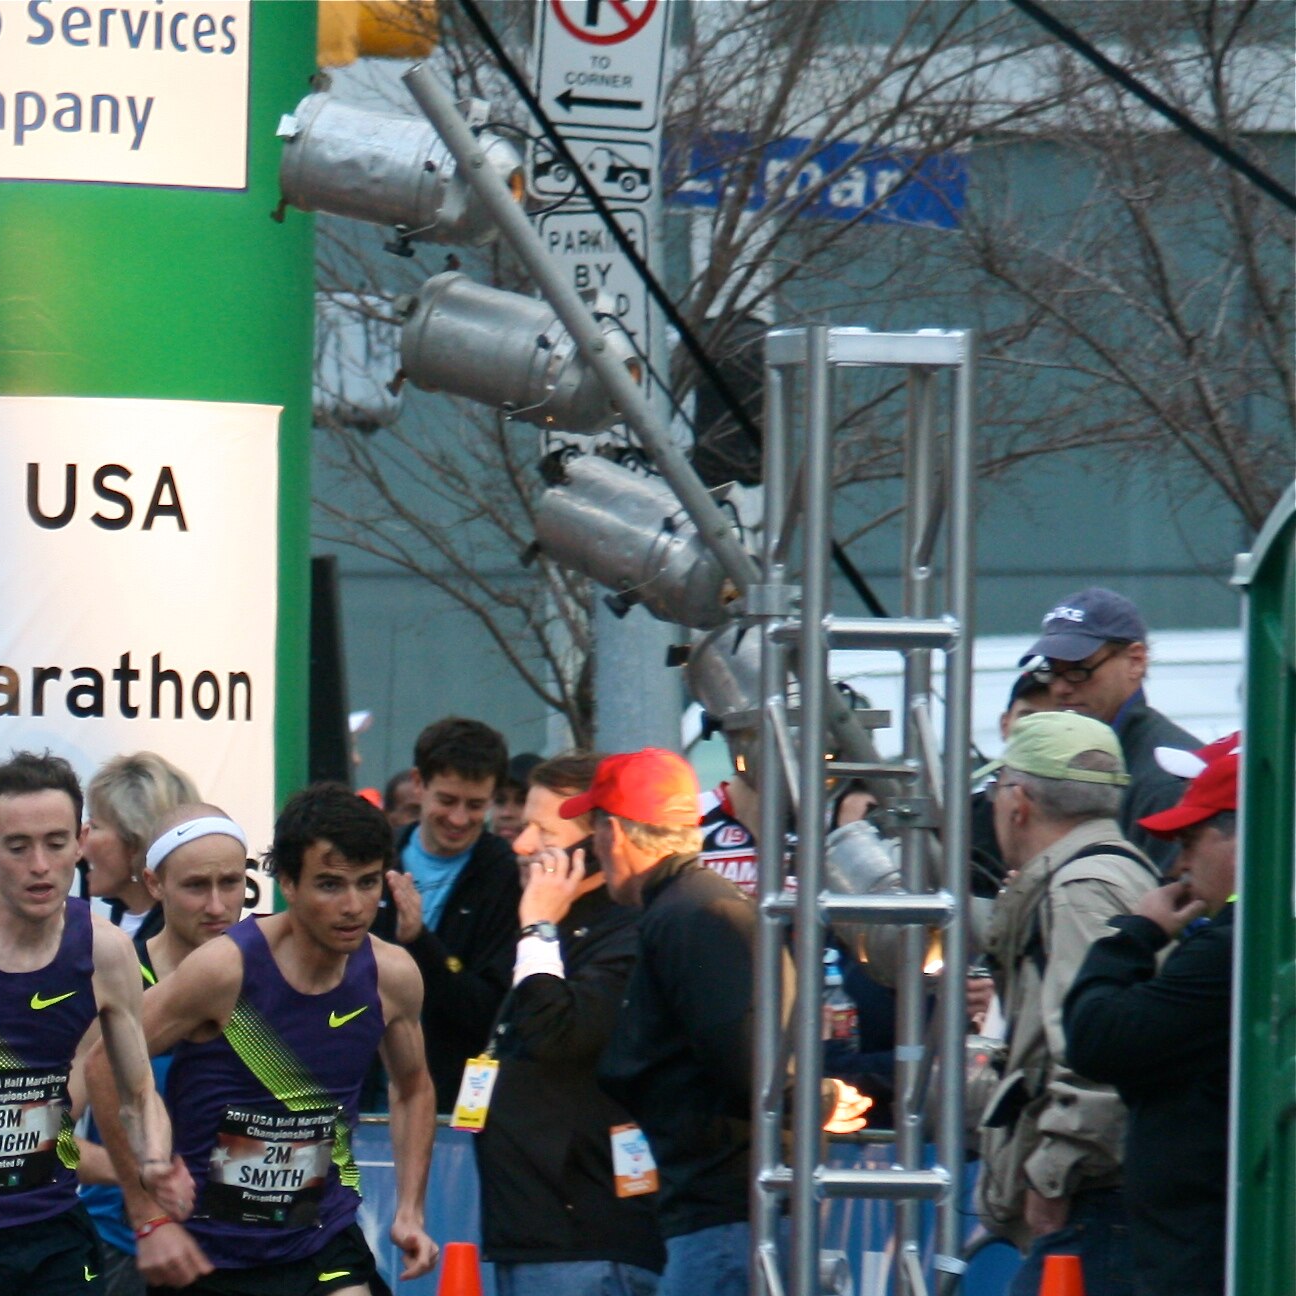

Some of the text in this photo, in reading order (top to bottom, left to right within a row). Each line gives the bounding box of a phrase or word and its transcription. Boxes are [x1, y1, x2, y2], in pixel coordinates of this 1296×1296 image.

[25, 0, 238, 55] Services
[590, 55, 611, 69] TO
[564, 71, 633, 88] CORNER
[574, 263, 613, 289] BY
[25, 462, 189, 533] USA
[4, 1076, 24, 1088] Half
[25, 1073, 67, 1087] Marathon
[226, 1110, 250, 1122] 2011
[252, 1114, 273, 1127] USA
[276, 1117, 294, 1127] Half
[246, 1126, 315, 1140] Championships
[16, 1158, 25, 1168] By
[262, 1146, 293, 1165] 2M
[238, 1165, 305, 1188] SMYTH
[242, 1191, 282, 1203] Presented
